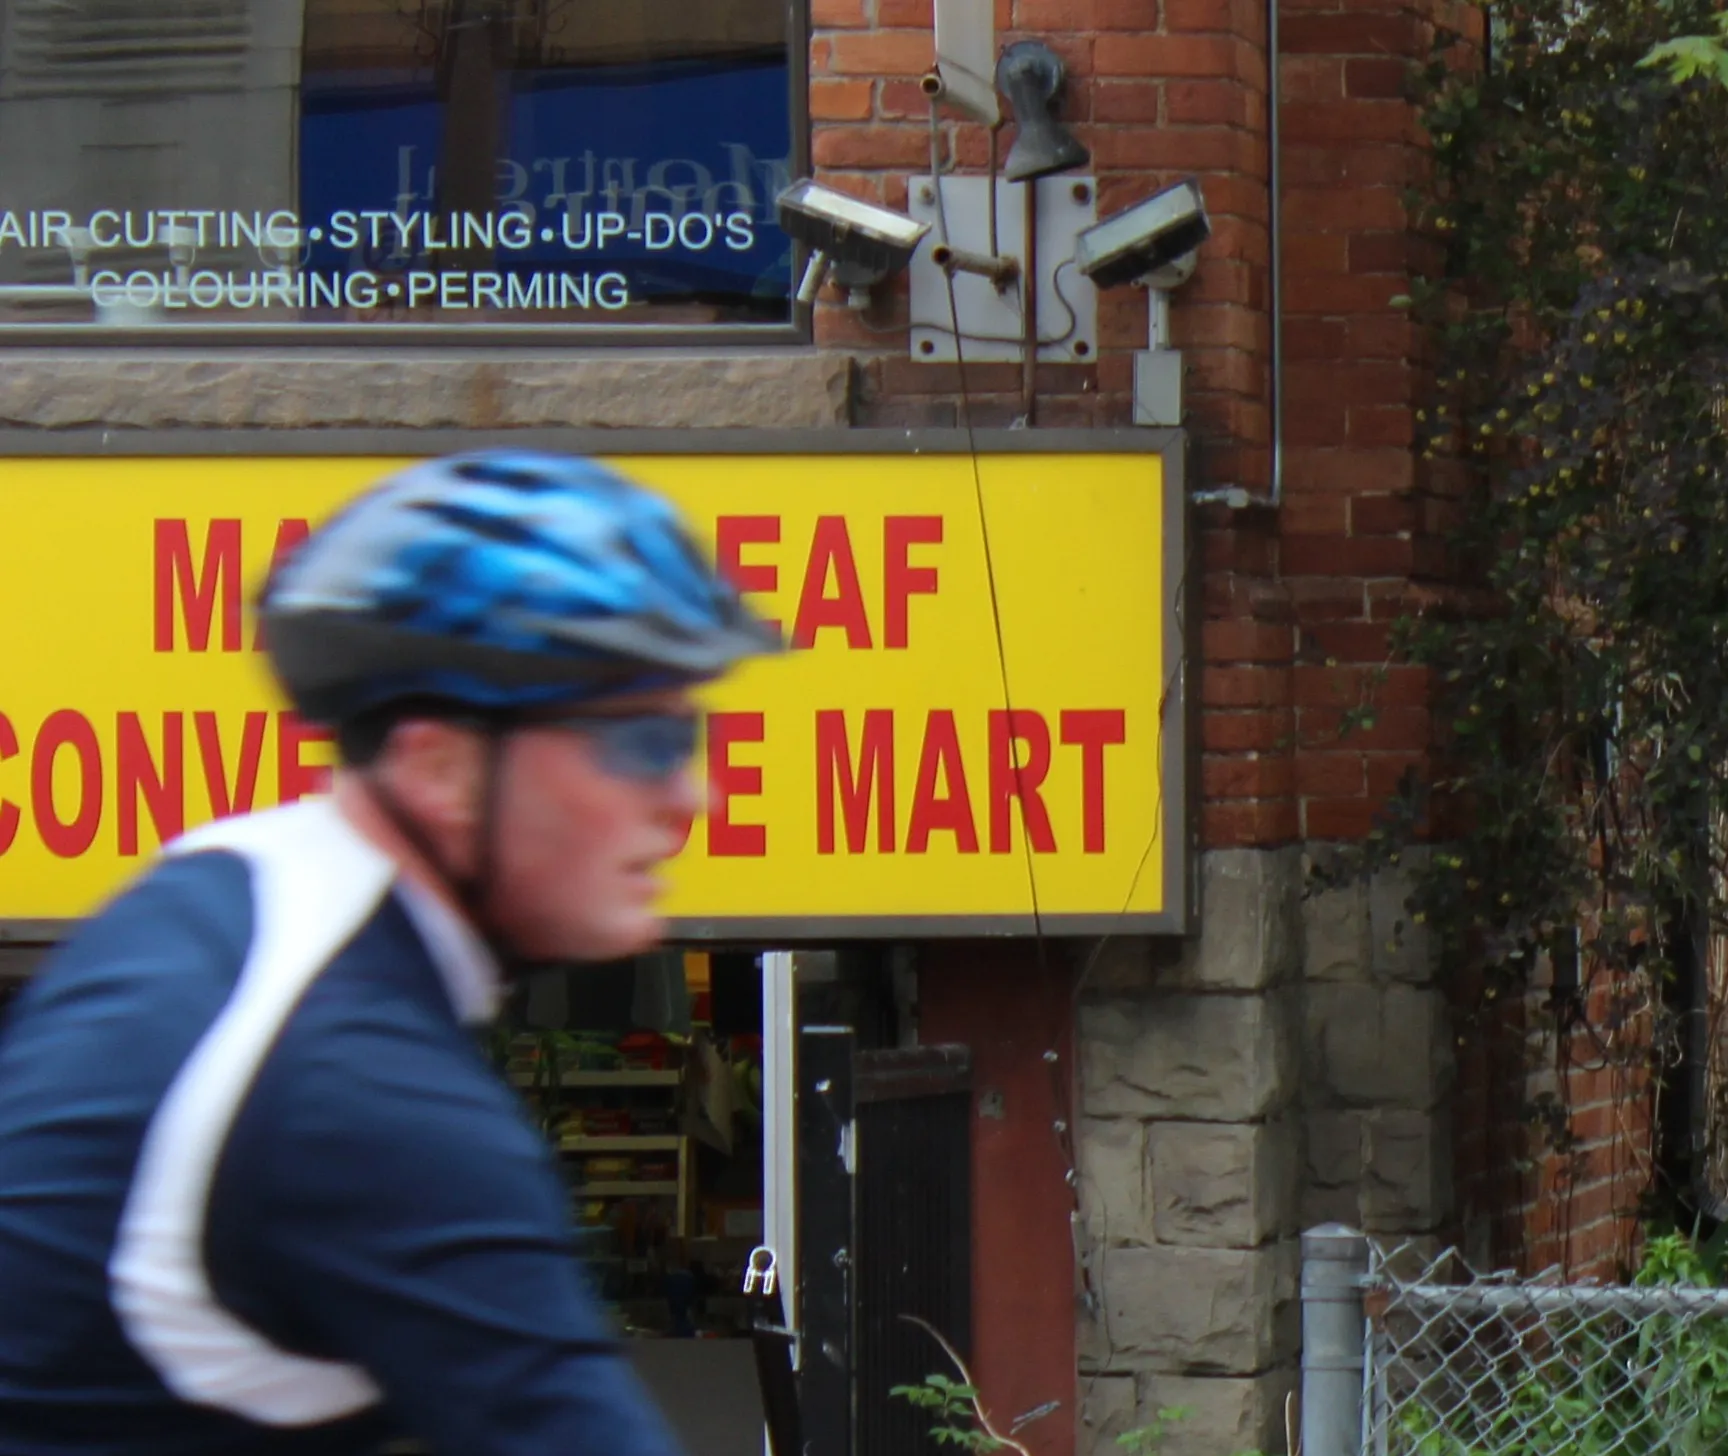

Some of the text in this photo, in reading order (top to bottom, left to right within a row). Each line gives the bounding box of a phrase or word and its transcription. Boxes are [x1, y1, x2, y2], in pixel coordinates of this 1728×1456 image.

[0, 211, 72, 248] AIR
[88, 209, 299, 249] CUTTING
[329, 211, 532, 250] STYLING
[562, 211, 755, 251] UP-DO'S
[91, 270, 628, 310] COLOURING PERMING
[715, 515, 943, 651] EAF
[815, 707, 1127, 855] MART
